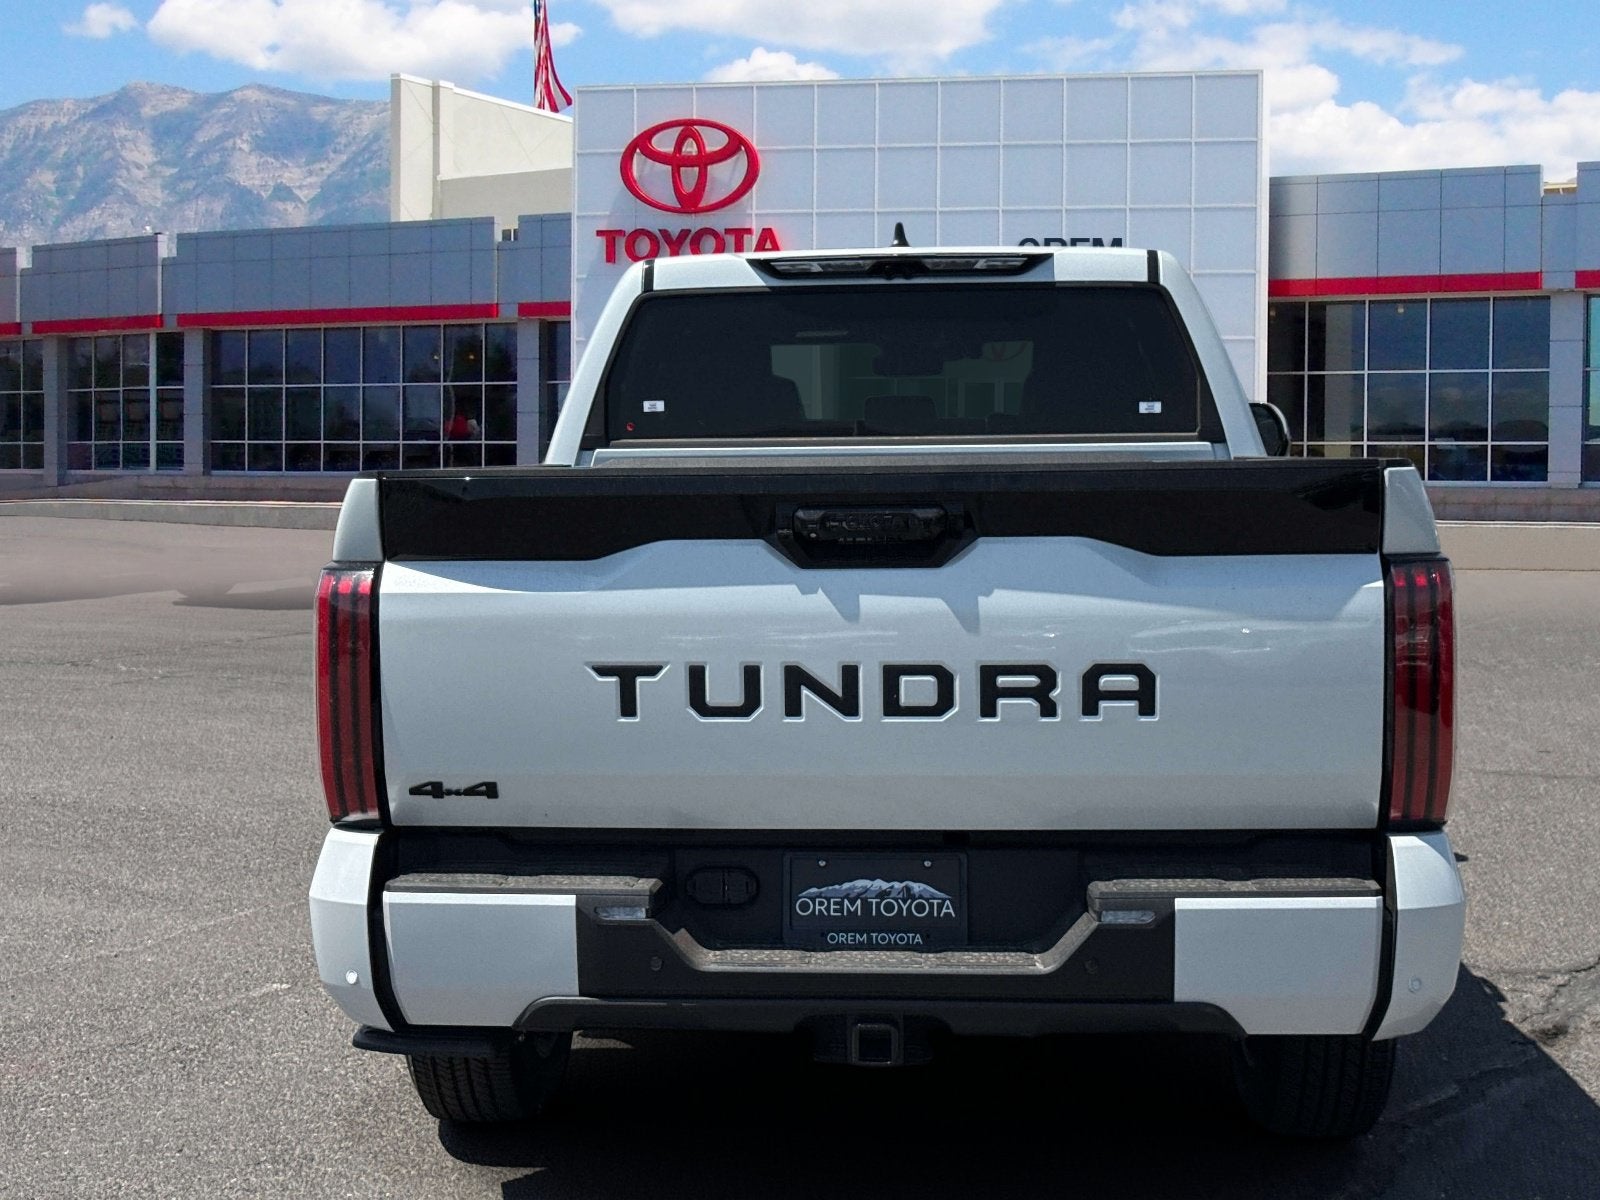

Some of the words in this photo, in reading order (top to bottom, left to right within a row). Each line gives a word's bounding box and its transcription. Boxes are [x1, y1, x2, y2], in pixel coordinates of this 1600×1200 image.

[596, 227, 781, 264] TOYOTA
[588, 663, 1158, 719] TUNDRA
[795, 898, 861, 916] OREM
[867, 898, 956, 917] TOYOTA
[827, 932, 867, 944] OREM
[870, 932, 923, 945] TOYOTA
